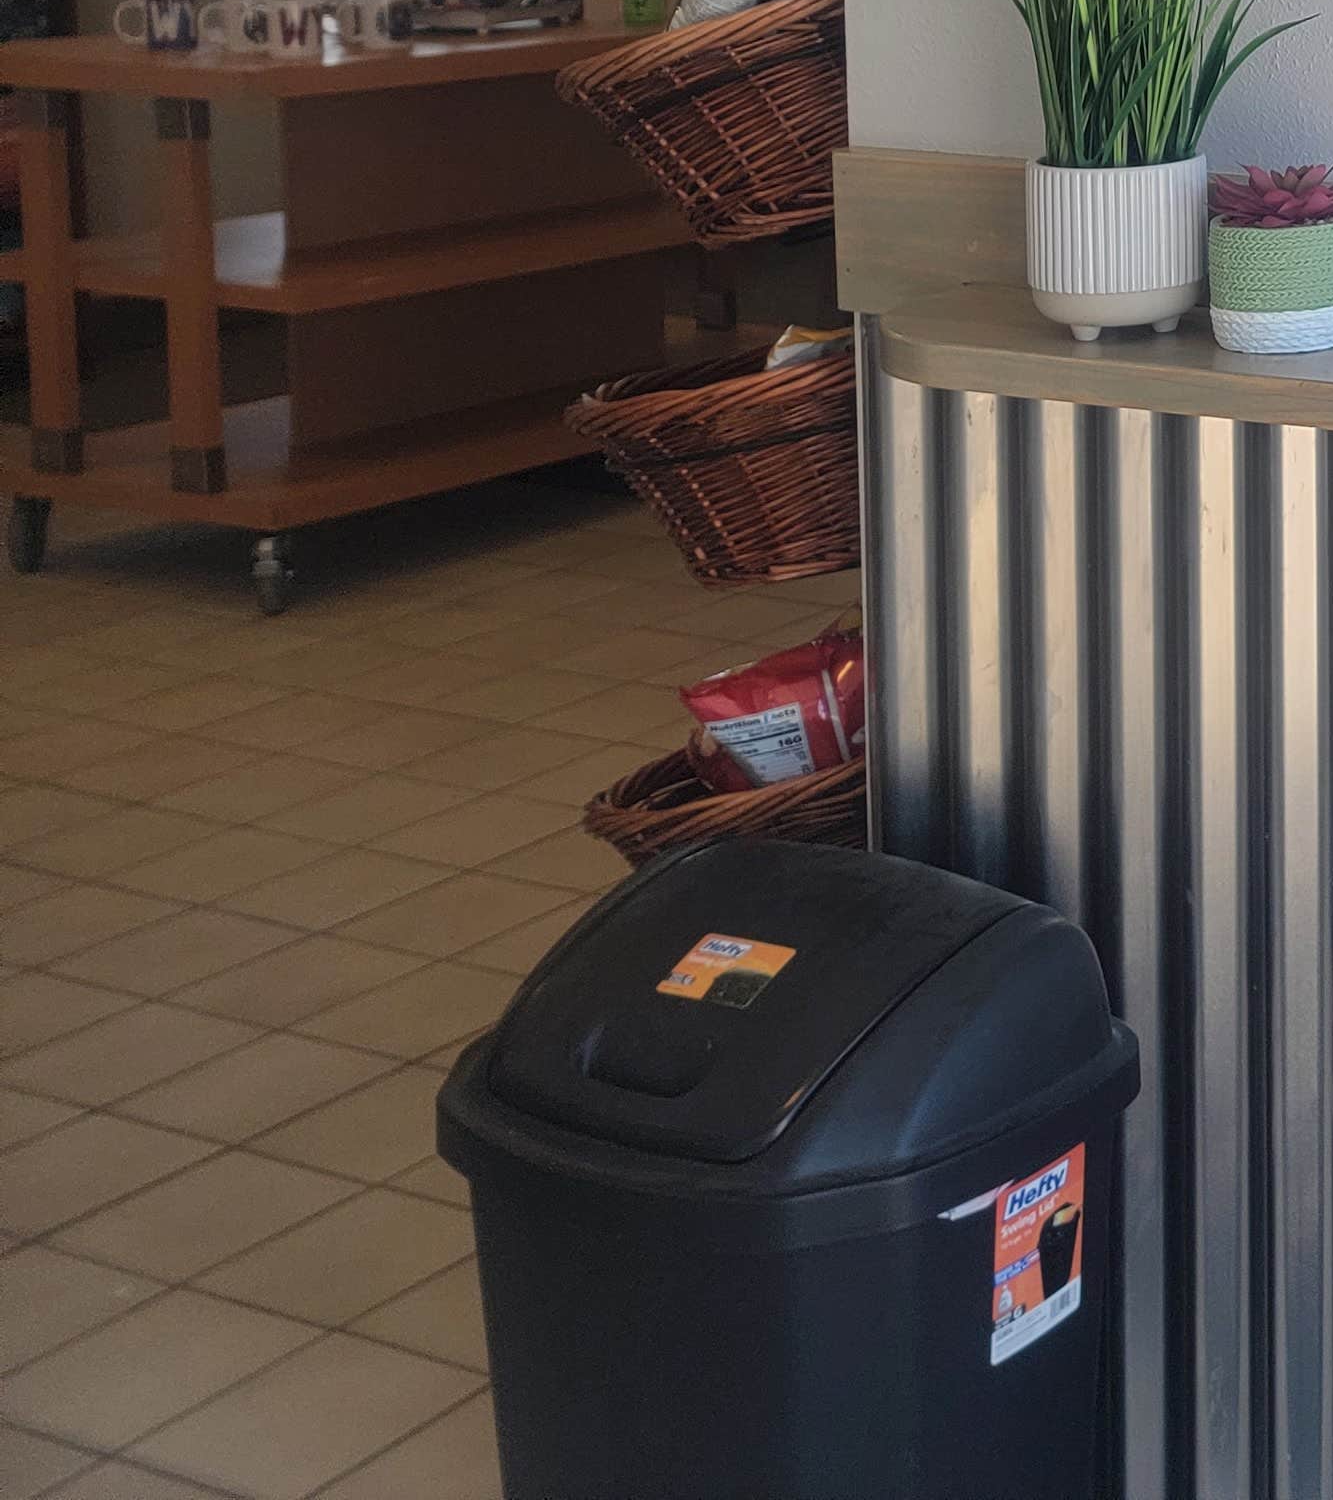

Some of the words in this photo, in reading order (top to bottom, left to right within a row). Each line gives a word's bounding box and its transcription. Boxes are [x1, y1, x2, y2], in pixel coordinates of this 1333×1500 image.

[704, 940, 745, 957] Hefty
[1008, 1168, 1065, 1215] Hefty
[1001, 1210, 1036, 1239] Swing
